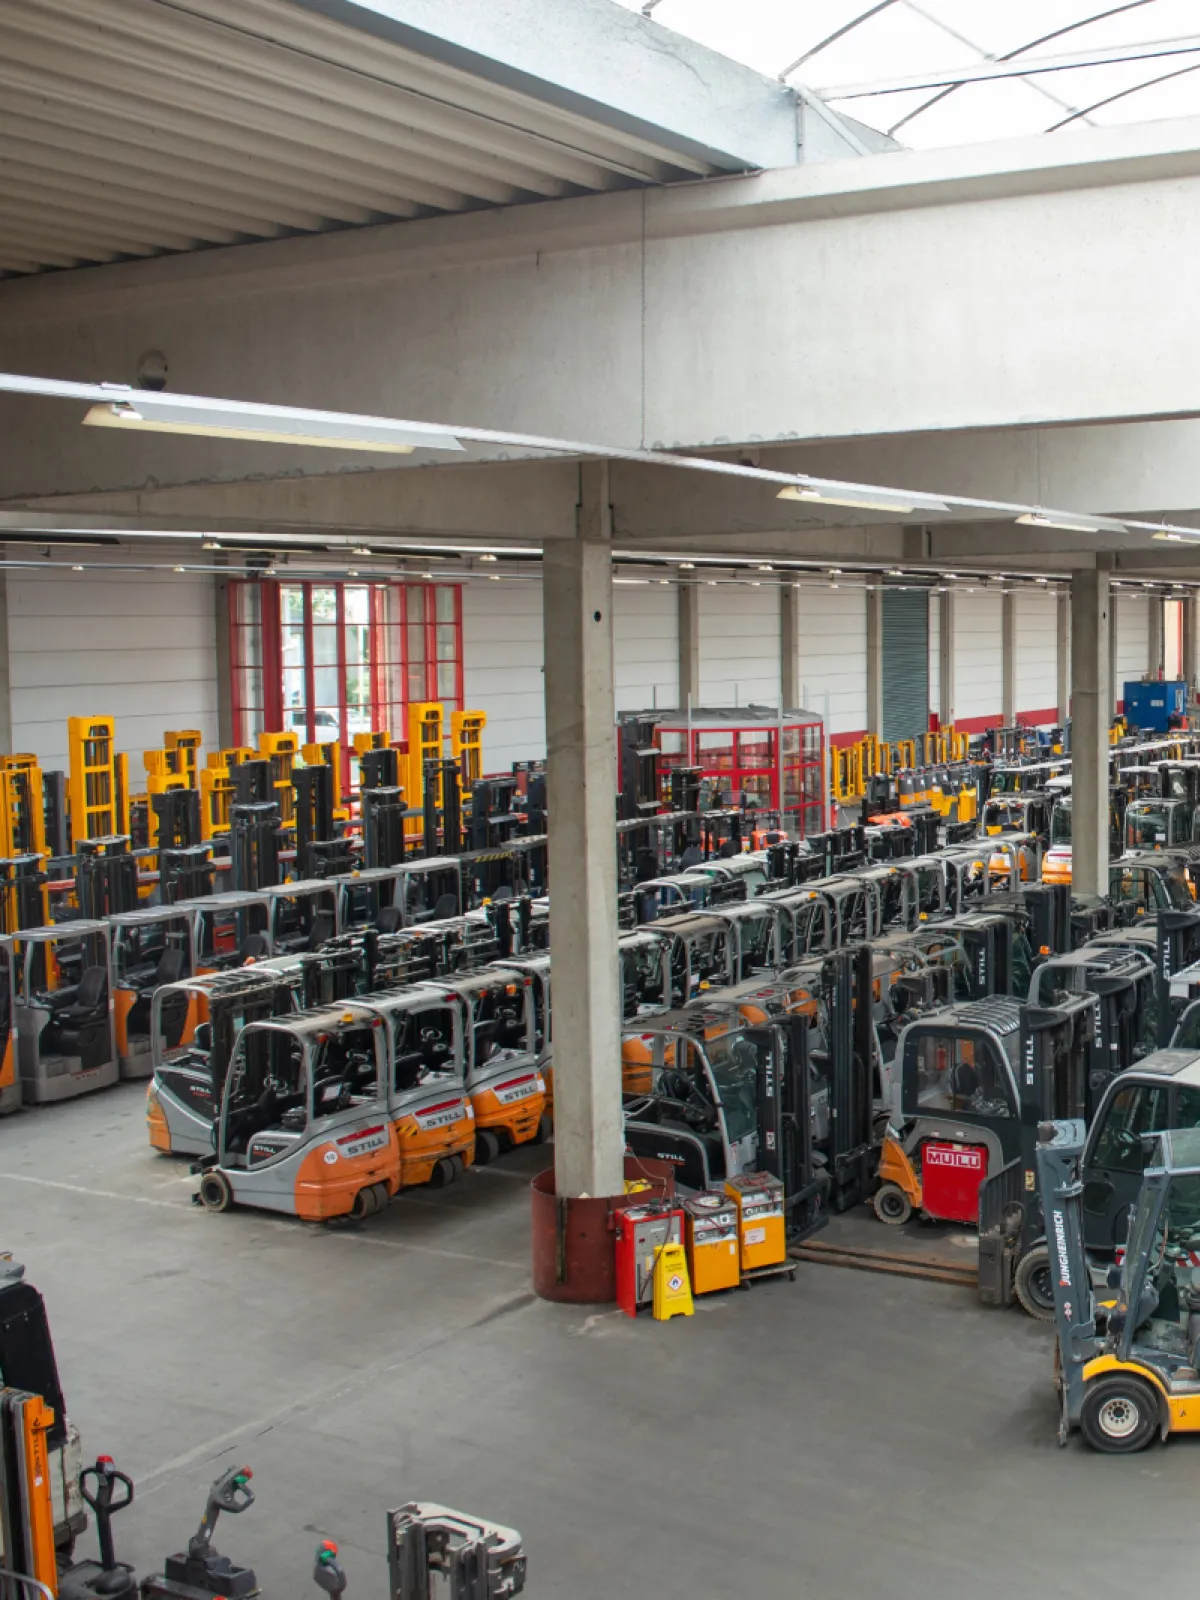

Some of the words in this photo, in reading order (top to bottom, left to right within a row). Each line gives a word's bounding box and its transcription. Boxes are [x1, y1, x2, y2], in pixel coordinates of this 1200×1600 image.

[978, 947, 986, 985] STILL
[1163, 936, 1171, 980] STILL
[1094, 1002, 1103, 1049] STILL
[766, 1050, 774, 1097] STILL
[1026, 1034, 1034, 1085] STILL
[504, 1086, 535, 1101] STILL
[426, 1112, 461, 1128] STILL
[348, 1138, 385, 1155] STILL
[656, 1152, 686, 1162] STILL
[1052, 1209, 1072, 1287] JUNGHEINRICH
